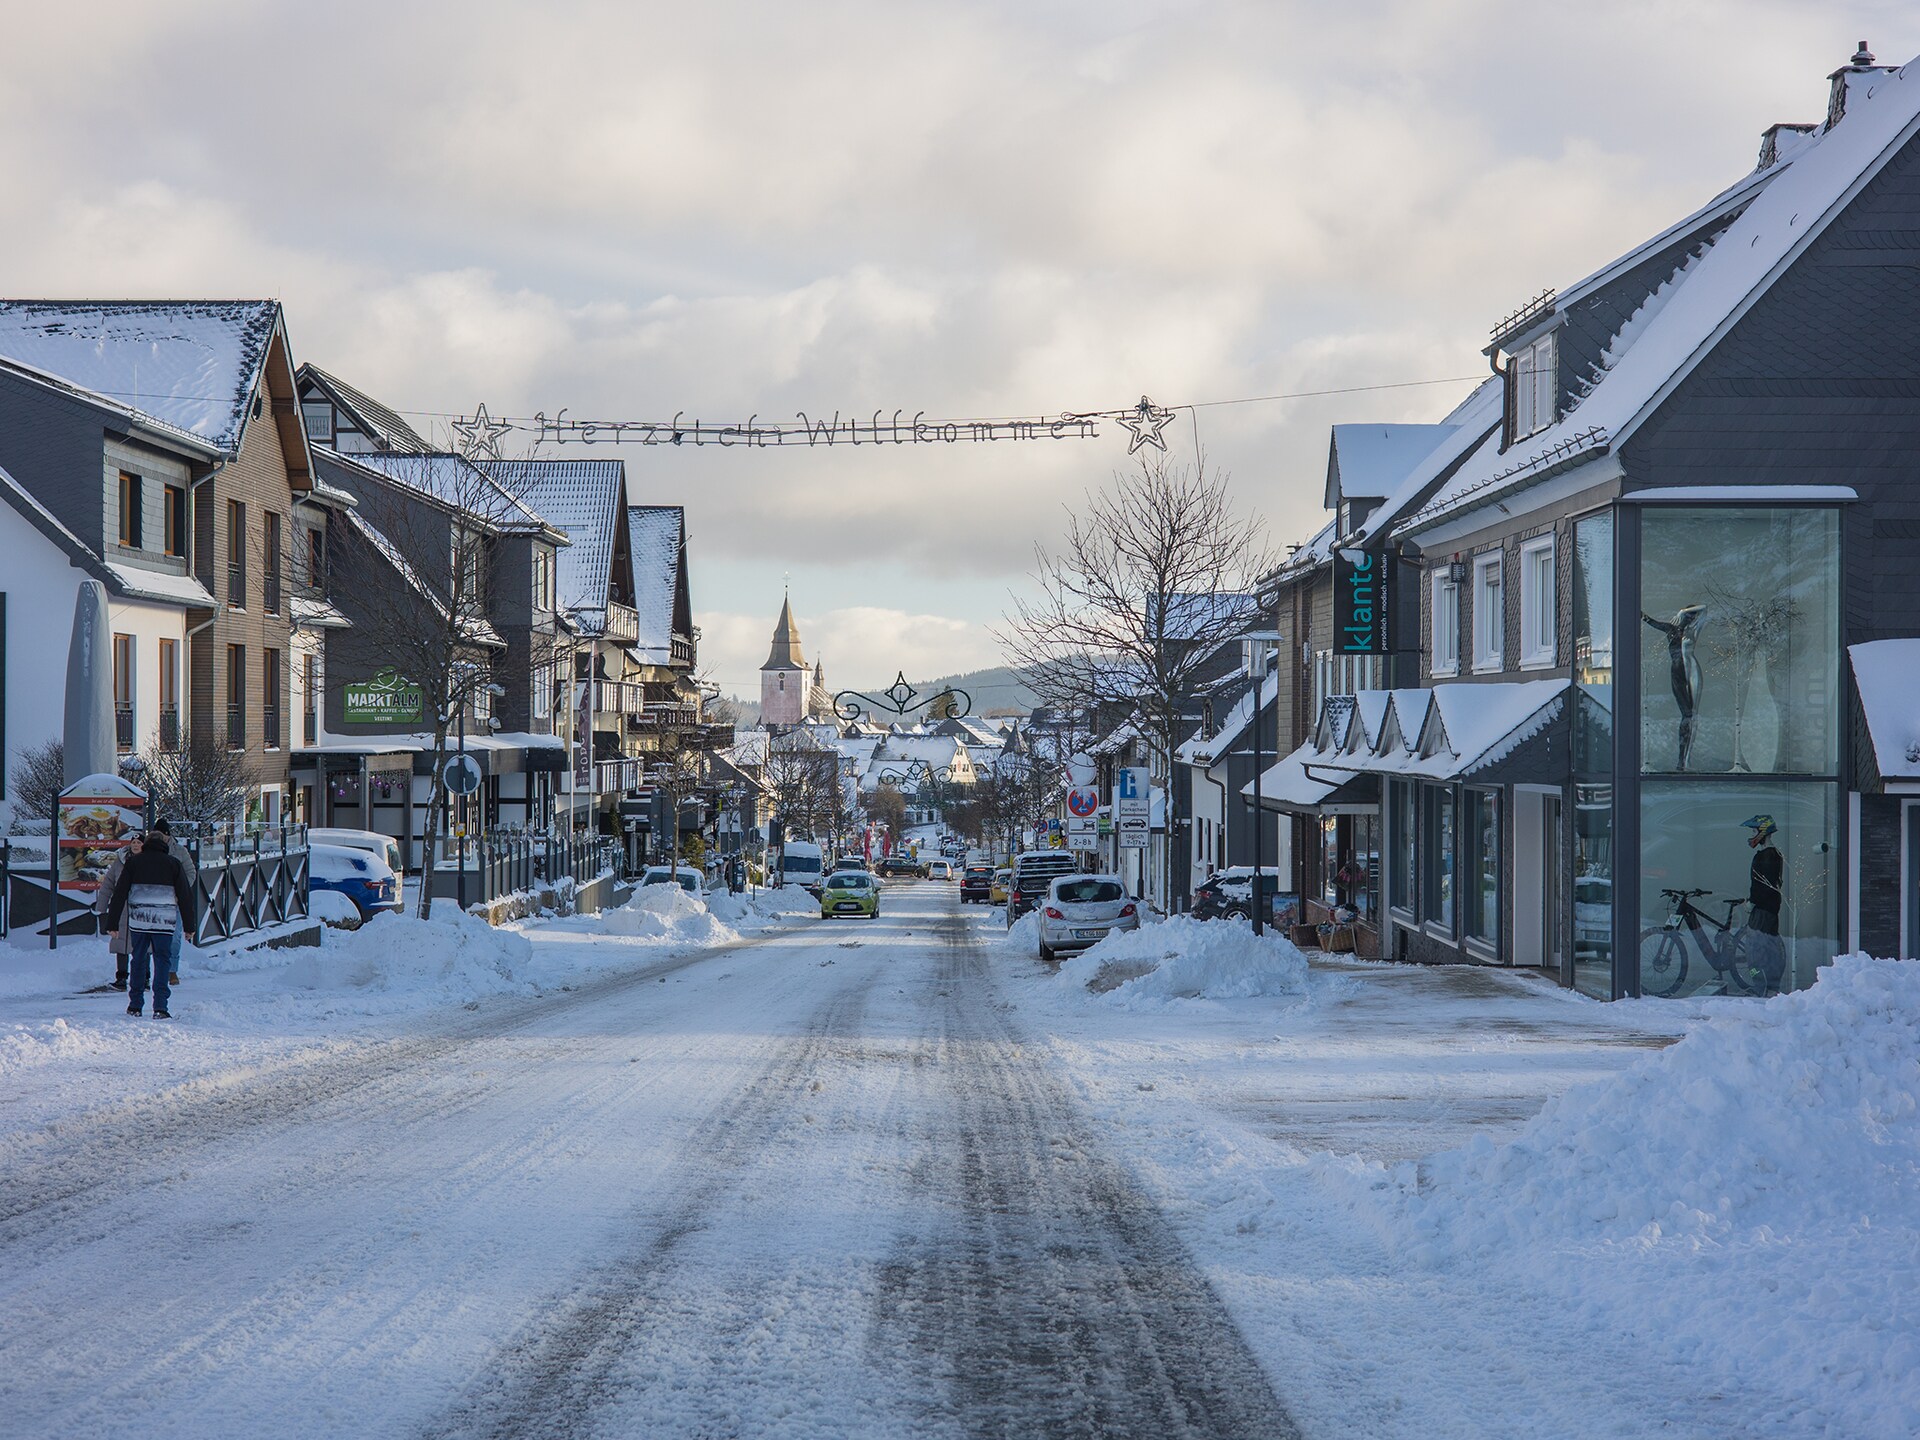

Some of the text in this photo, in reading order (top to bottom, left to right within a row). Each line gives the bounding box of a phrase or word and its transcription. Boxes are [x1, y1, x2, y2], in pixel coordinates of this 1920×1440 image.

[534, 408, 1100, 447] Herzlich Willkommen
[1380, 553, 1388, 579] exclusiv
[1344, 554, 1373, 651] klante
[1380, 584, 1388, 612] modisch
[347, 693, 420, 707] MARKTALM
[1051, 820, 1057, 828] P
